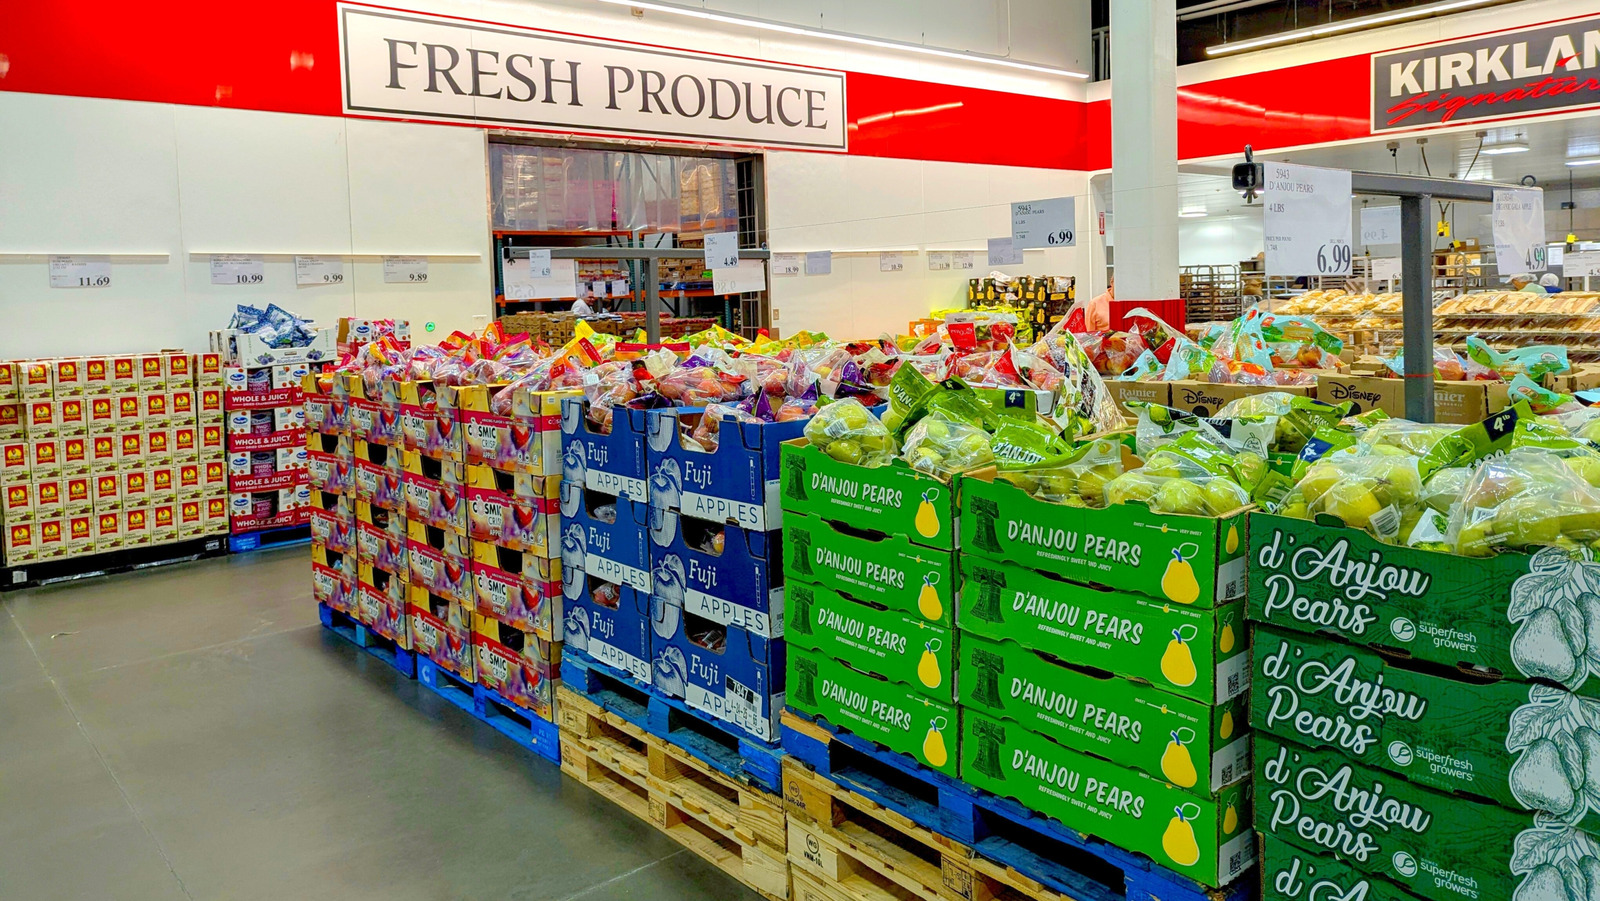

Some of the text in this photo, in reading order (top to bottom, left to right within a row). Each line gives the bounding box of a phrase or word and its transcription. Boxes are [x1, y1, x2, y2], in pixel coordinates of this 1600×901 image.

[1390, 30, 1600, 98] KIRKLAN
[383, 37, 828, 130] FRESH PRODUCE
[1386, 76, 1600, 126] Signatur
[1269, 181, 1314, 193] D'ANJOU PEARS
[1276, 168, 1290, 180] 5943
[1269, 203, 1285, 213] 4 LBS
[1047, 230, 1073, 245] 6.99
[724, 256, 738, 266] 4.49
[1317, 244, 1351, 273] 6.99
[1526, 247, 1546, 270] 4.99
[79, 276, 110, 287] 11.69
[236, 274, 264, 284] 10.99
[323, 274, 343, 283] 9.99
[409, 273, 428, 282] 9.89
[268, 392, 288, 400] JUICY
[1120, 388, 1157, 400] Rainier
[270, 434, 291, 443] JUICY
[482, 438, 497, 450] CRISP
[588, 442, 608, 468] Fuji
[270, 476, 292, 484] JUICY
[598, 473, 642, 496] APPLES
[684, 461, 712, 490] Fuji
[812, 472, 903, 508] D'ANJOU PEARS
[696, 496, 758, 524] APPLES
[589, 526, 611, 553] Fuji
[1008, 519, 1142, 568] D'ANJOU PEARS
[598, 559, 646, 588] APPLES
[688, 559, 718, 590] Fuji
[816, 548, 905, 589] D'ANJOU PEARS
[1036, 550, 1070, 562] REFRESHINGLY
[1071, 556, 1086, 566] SWEET
[1098, 562, 1112, 572] JUICY
[1260, 531, 1430, 600] d'Anjou
[492, 593, 507, 607] CRISP
[701, 596, 764, 631] APPLES
[1264, 574, 1377, 635] Pears
[592, 612, 614, 639] Fuji
[818, 608, 907, 654] D'ANJOU PEARS
[1012, 591, 1144, 645] D'ANJOU PEARS
[1038, 623, 1112, 650] REFRESHINGLY SWEET AND JUICY
[1418, 624, 1477, 643] superfresh
[1433, 637, 1477, 654] growers
[601, 644, 647, 678] APPLES
[690, 654, 719, 686] Fuji
[1263, 641, 1428, 721] d'Anjou
[822, 679, 912, 731] D'ANJOU PEARS
[1010, 677, 1142, 744] D'ANJOU PEARS
[1036, 712, 1112, 744] REFRESHINGLY SWEET AND JUICY
[1267, 685, 1378, 754] Pears
[1416, 748, 1474, 772] superfresh
[1430, 763, 1474, 782] growers
[1012, 749, 1144, 818] D'ANJOU PEARS
[1264, 746, 1430, 833] d'Anjou
[1038, 784, 1113, 820] REFRESHINGLY SWEET AND JUICY
[1270, 789, 1378, 863] Pears
[1420, 860, 1478, 890] superfresh
[1434, 876, 1479, 900] growers
